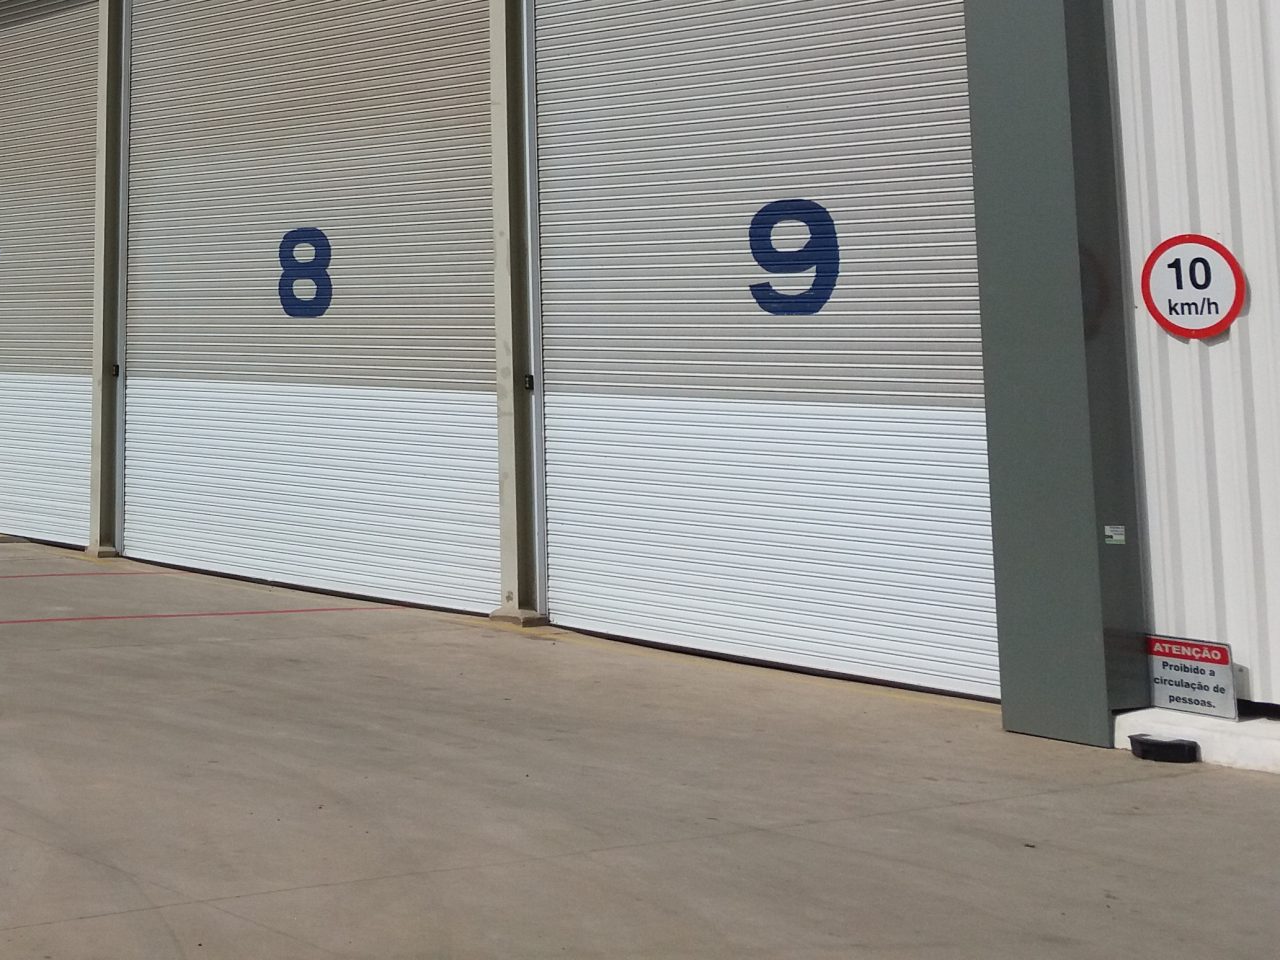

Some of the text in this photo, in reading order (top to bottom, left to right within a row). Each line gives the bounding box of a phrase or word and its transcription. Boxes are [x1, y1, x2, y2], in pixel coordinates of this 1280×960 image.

[748, 198, 840, 316] 9
[278, 227, 333, 318] 8
[1167, 257, 1212, 290] 10
[1167, 297, 1220, 316] km/h
[1153, 642, 1222, 660] ATENÇÃO
[1162, 660, 1216, 677] Proibido a
[1153, 676, 1226, 694] circulação de
[1168, 695, 1216, 709] pessoas.
